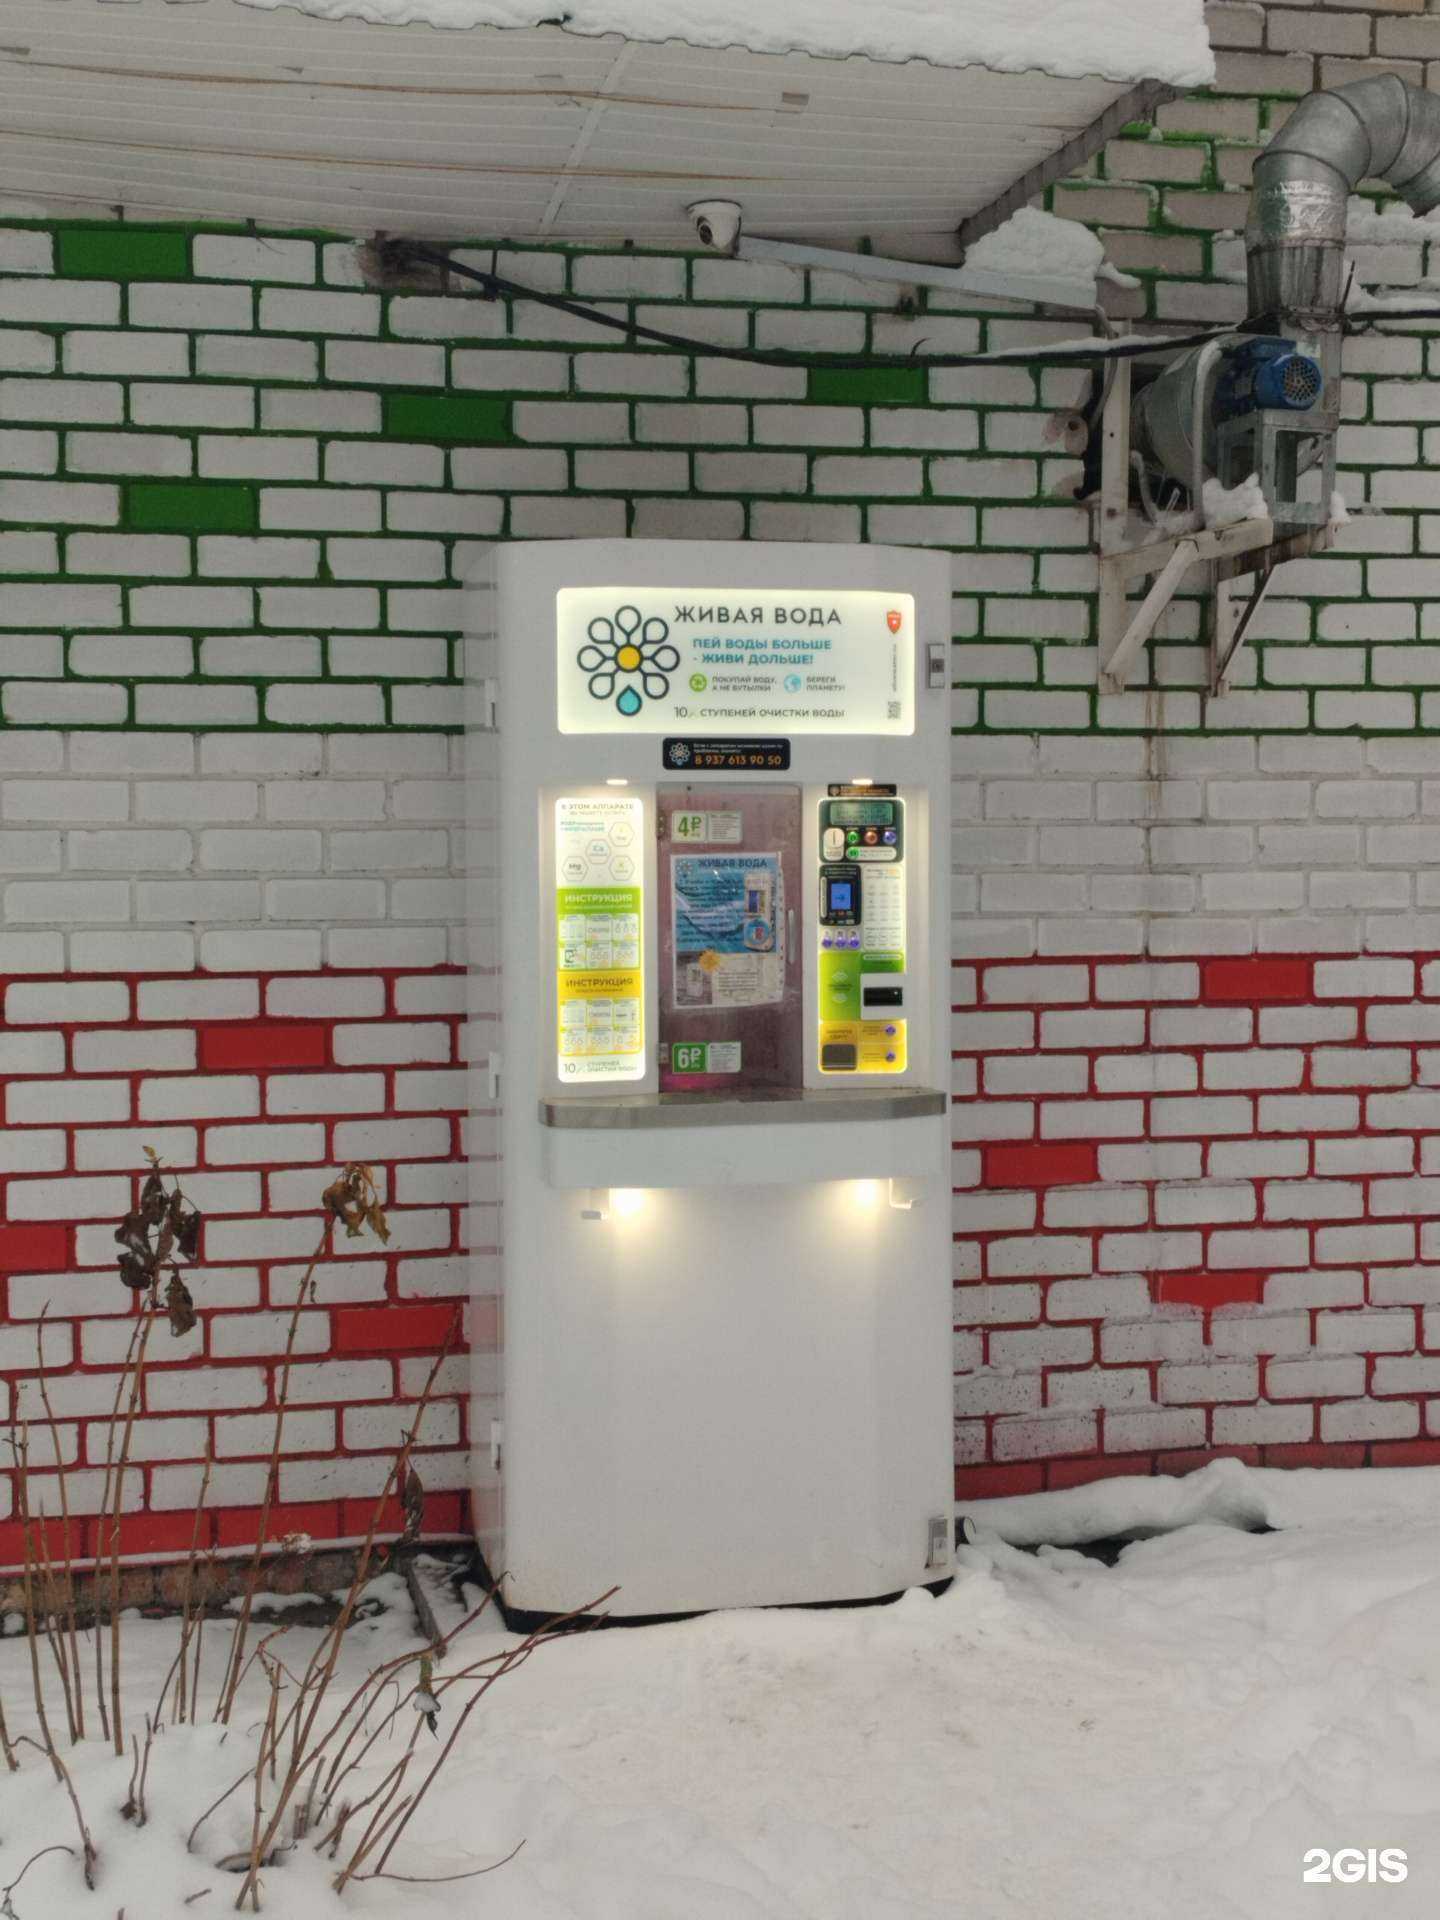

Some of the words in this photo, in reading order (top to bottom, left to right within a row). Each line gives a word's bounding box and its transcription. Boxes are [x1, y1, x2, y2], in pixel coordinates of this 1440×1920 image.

[674, 606, 764, 624] ЖИВАЯ
[774, 607, 842, 627] ВОДА
[693, 637, 721, 650] ПЕЙ
[725, 638, 768, 651] ВОДЫ
[772, 639, 832, 651] БОЛЬШЕ
[702, 654, 744, 665] ЖИВИ
[748, 654, 814, 666] ДОЛЬШЕ!
[674, 706, 688, 718] 10
[700, 707, 756, 718] СТУПЕНЕЙ
[759, 708, 809, 718] ОЧИСТКИ
[812, 709, 845, 718] ВОДЫ
[694, 755, 702, 765] 8
[705, 755, 725, 765] 937
[750, 755, 764, 765] 90
[767, 755, 781, 765] 50
[698, 858, 735, 868] ЖИВАЯ
[738, 858, 768, 868] ВОДА
[565, 894, 633, 905] ИНСТРУКЦИЯ
[565, 977, 634, 988] ИНСТРУКЦИЯ
[564, 1062, 577, 1074] 10
